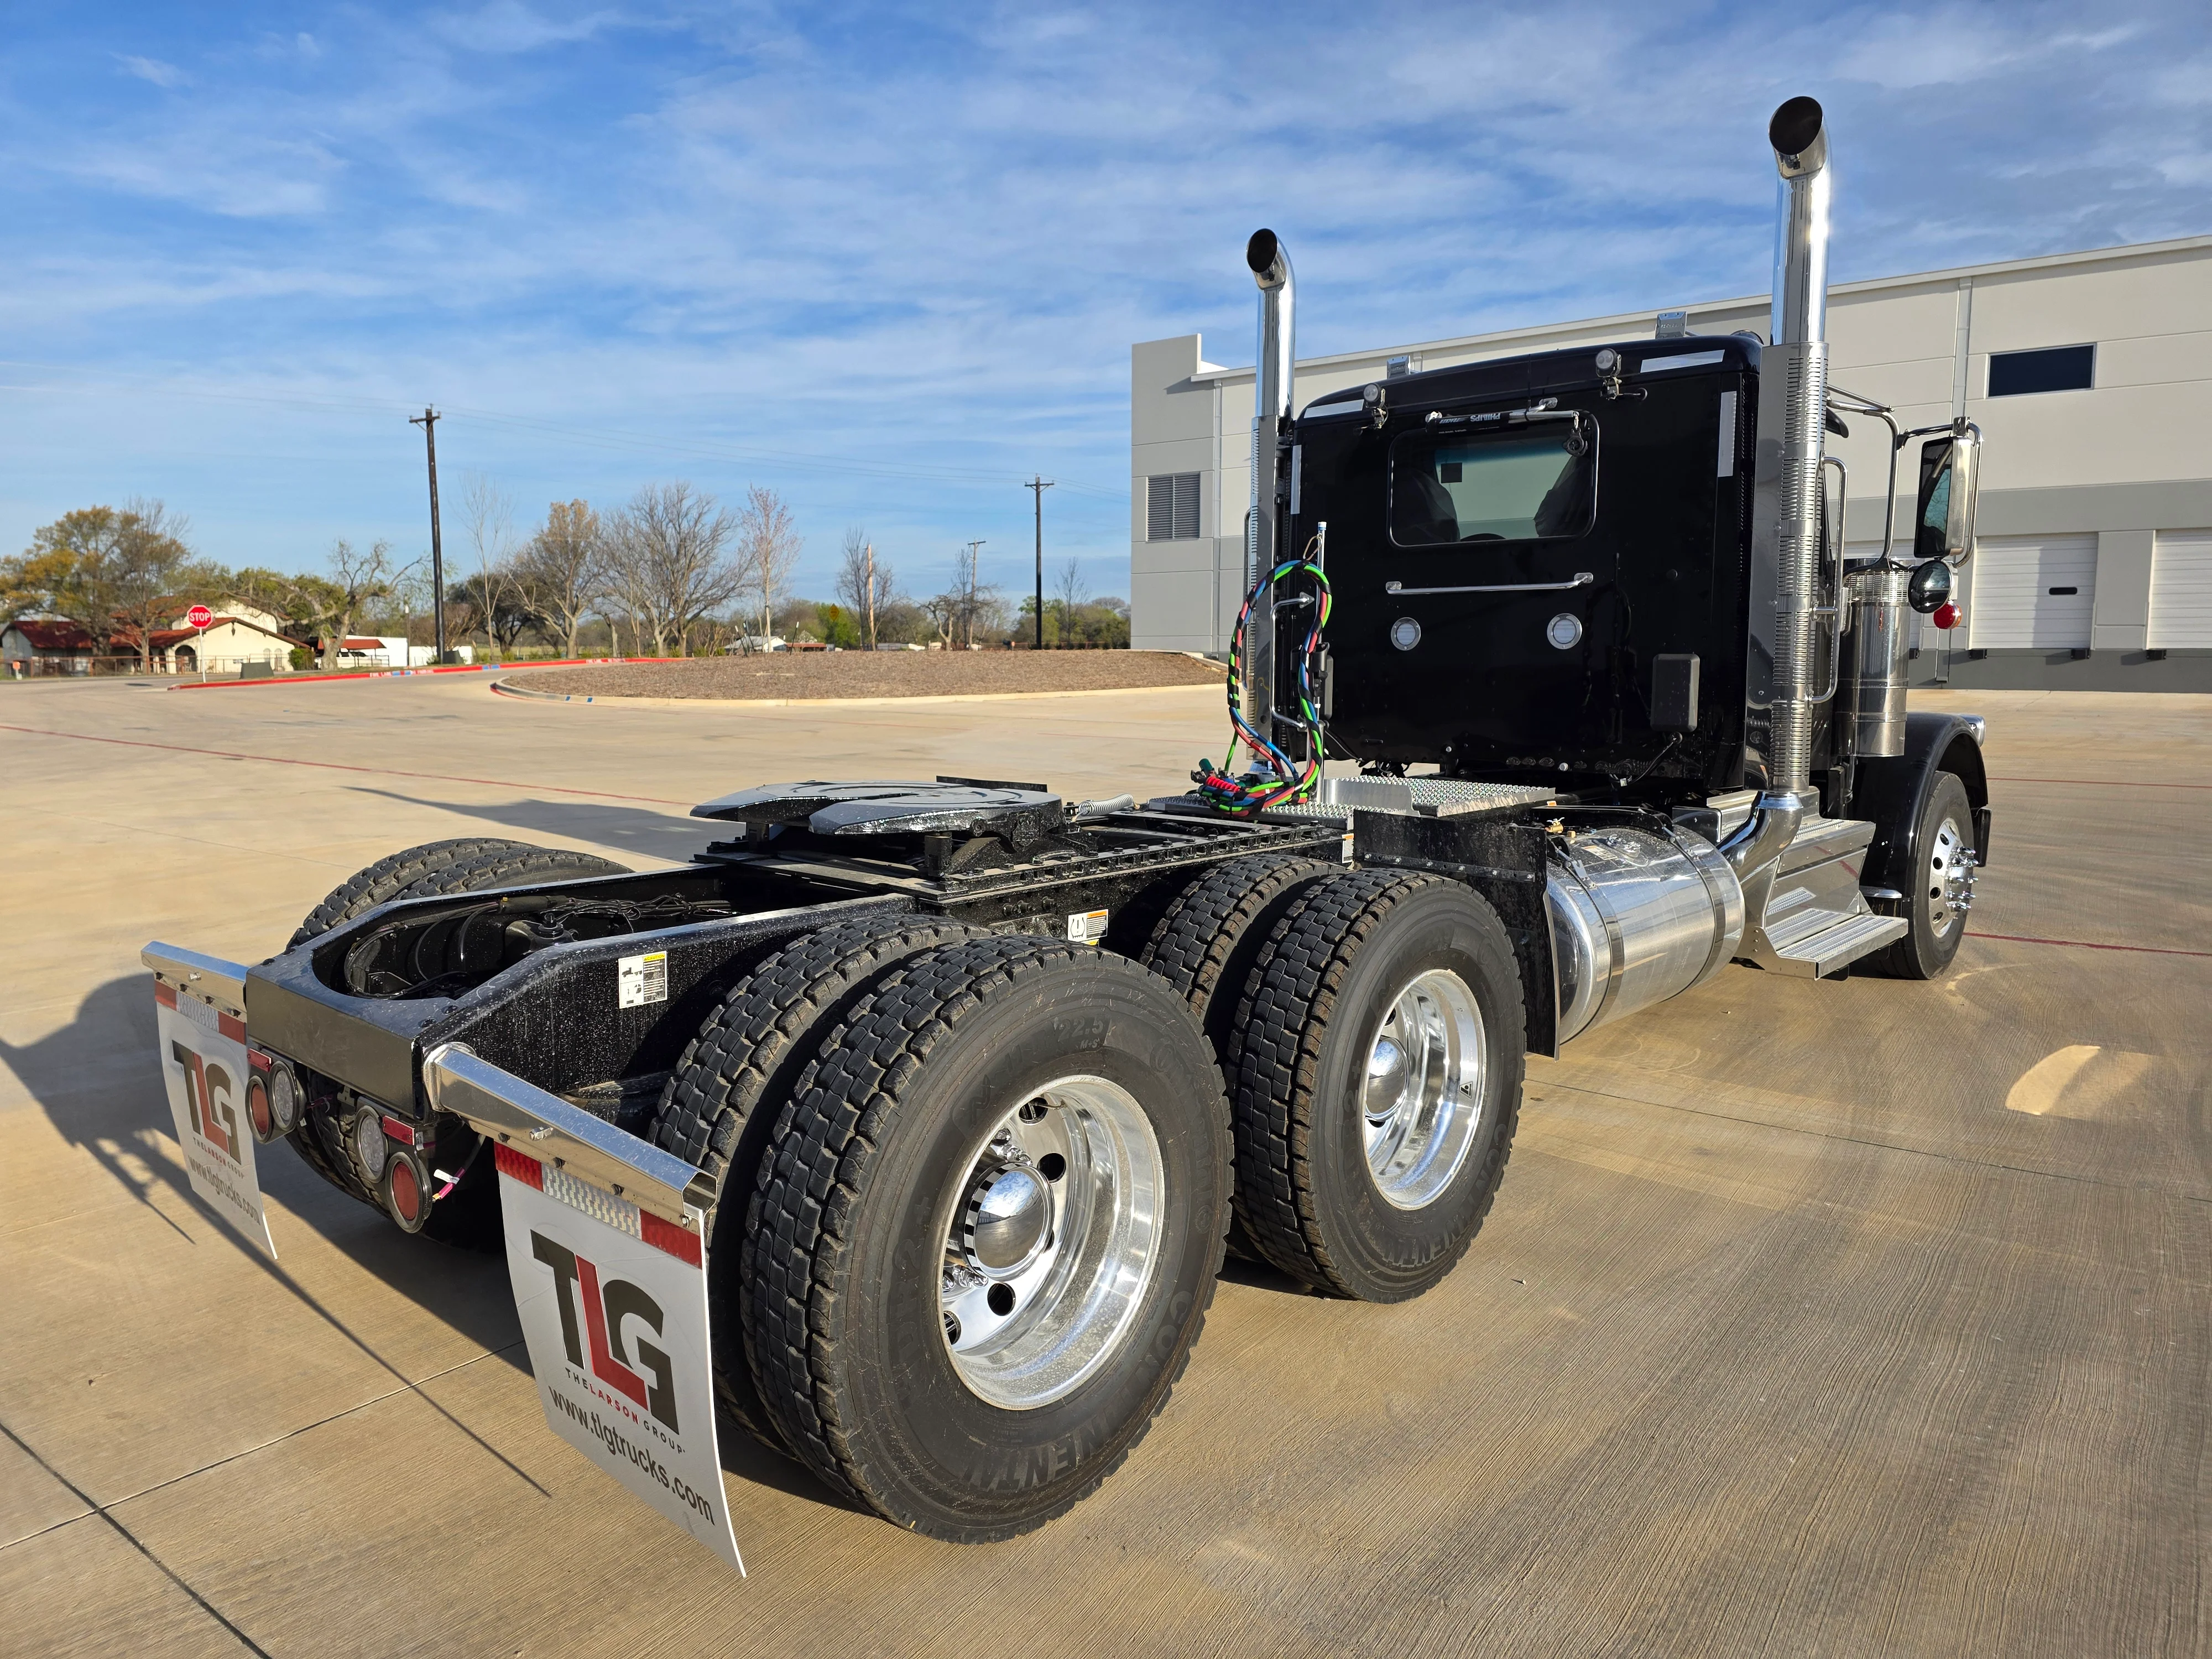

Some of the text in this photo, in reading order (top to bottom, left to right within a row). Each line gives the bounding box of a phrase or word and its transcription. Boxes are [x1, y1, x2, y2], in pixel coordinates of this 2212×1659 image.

[190, 612, 210, 622] STOP
[171, 1039, 242, 1165] TLG
[187, 1154, 261, 1226] www.tlgtrucks.com
[227, 1161, 244, 1179] GROUP
[530, 1229, 679, 1435] TLG
[548, 1385, 715, 1526] www.tlgtrucks.com
[643, 1420, 683, 1454] GROUP
